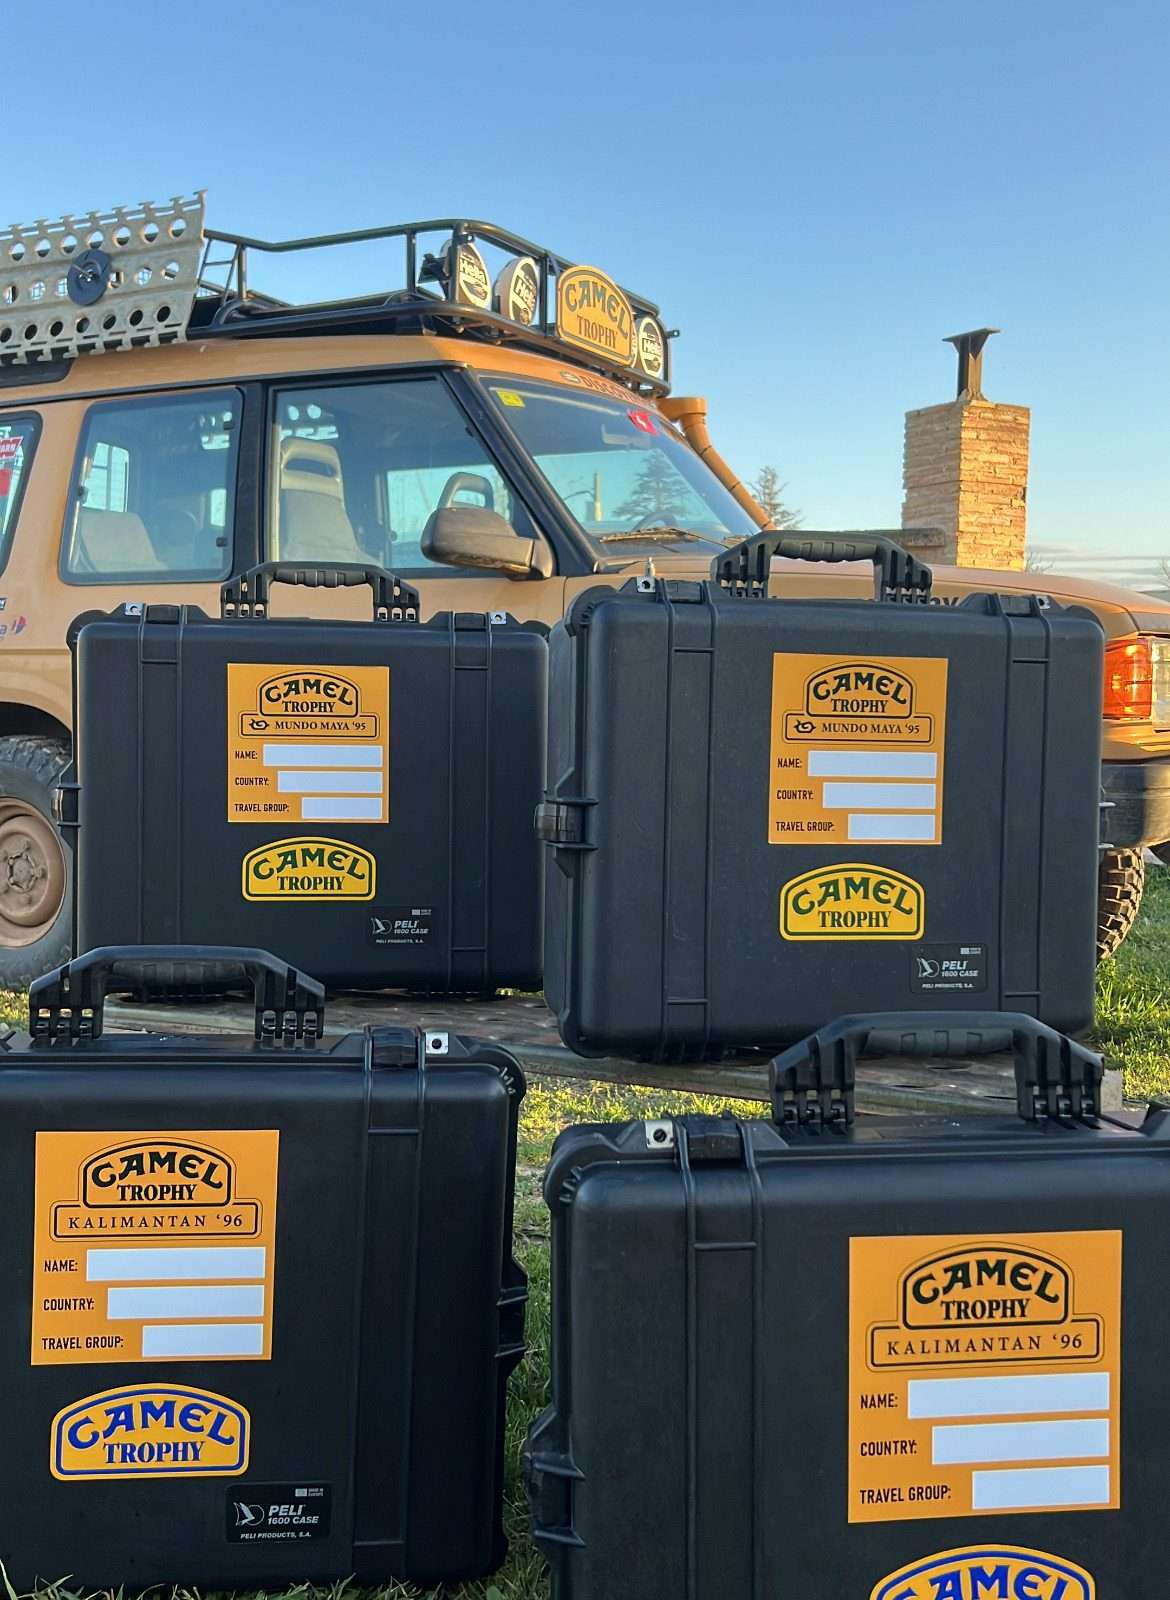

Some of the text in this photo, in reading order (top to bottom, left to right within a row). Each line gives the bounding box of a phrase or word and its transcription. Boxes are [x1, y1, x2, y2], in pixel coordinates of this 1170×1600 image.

[565, 280, 629, 340] CAMEL
[577, 314, 617, 349] TROPHY
[265, 679, 353, 706] CAMEL
[813, 672, 907, 705] CAMEL
[282, 700, 336, 713] TROPHY
[831, 698, 888, 713] TROPHY
[274, 721, 318, 730] MUNDO
[319, 721, 350, 731] MAYA
[821, 722, 868, 733] MUNDO
[870, 723, 902, 734] MAYA
[235, 750, 258, 760] NAME:
[777, 758, 803, 769] NAME:
[235, 777, 270, 786] COUNTRY:
[776, 789, 814, 801] COUNTRY:
[235, 803, 290, 812] TRAVEL GROUP:
[776, 821, 836, 832] TRAVEL GROUP:
[253, 847, 366, 880] CAMEL
[277, 876, 345, 891] TROPHY
[792, 876, 914, 916] CAMEL
[394, 920, 418, 929] PELI
[818, 911, 892, 929] TROPHY
[942, 960, 968, 970] PELI
[91, 1151, 224, 1190] CAMEL
[117, 1183, 197, 1201] TROPHY
[68, 1215, 206, 1229] KALIMANTAN
[44, 1259, 78, 1272] NAME:
[912, 1258, 1060, 1305] CAMEL
[43, 1298, 94, 1311] COUNTRY:
[940, 1298, 1031, 1320] TROPHY
[42, 1335, 124, 1350] TRAVEL GROUP:
[887, 1335, 1042, 1356] KALIMANTAN
[860, 1393, 899, 1409] NAME:
[67, 1400, 236, 1450] CAMEL
[103, 1440, 205, 1464] TROPHY
[860, 1440, 918, 1457] COUNTRY:
[860, 1485, 952, 1504] TRAVEL GROUP:
[268, 1504, 304, 1516] PELI
[267, 1515, 320, 1526] 1600 CASE
[240, 1532, 257, 1540] PELI
